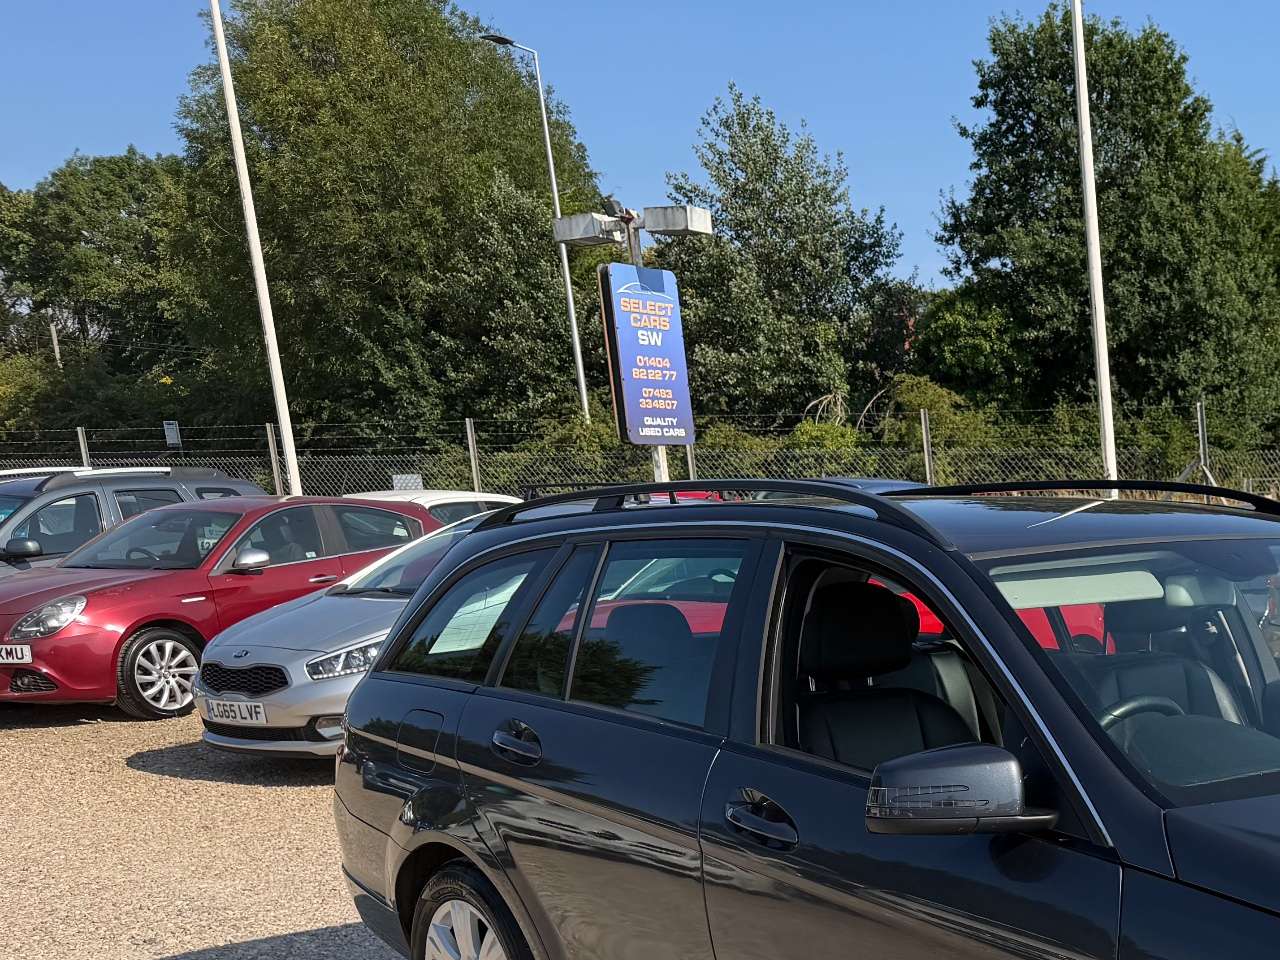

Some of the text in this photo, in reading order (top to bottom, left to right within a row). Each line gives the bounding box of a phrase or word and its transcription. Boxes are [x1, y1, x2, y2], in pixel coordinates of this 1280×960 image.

[621, 298, 673, 315] SELECT
[631, 314, 670, 330] CARS
[638, 330, 662, 346] SW
[636, 355, 671, 369] 01404
[643, 416, 678, 426] QUALITY
[639, 427, 686, 437] USED CARS
[239, 704, 261, 720] LVF
